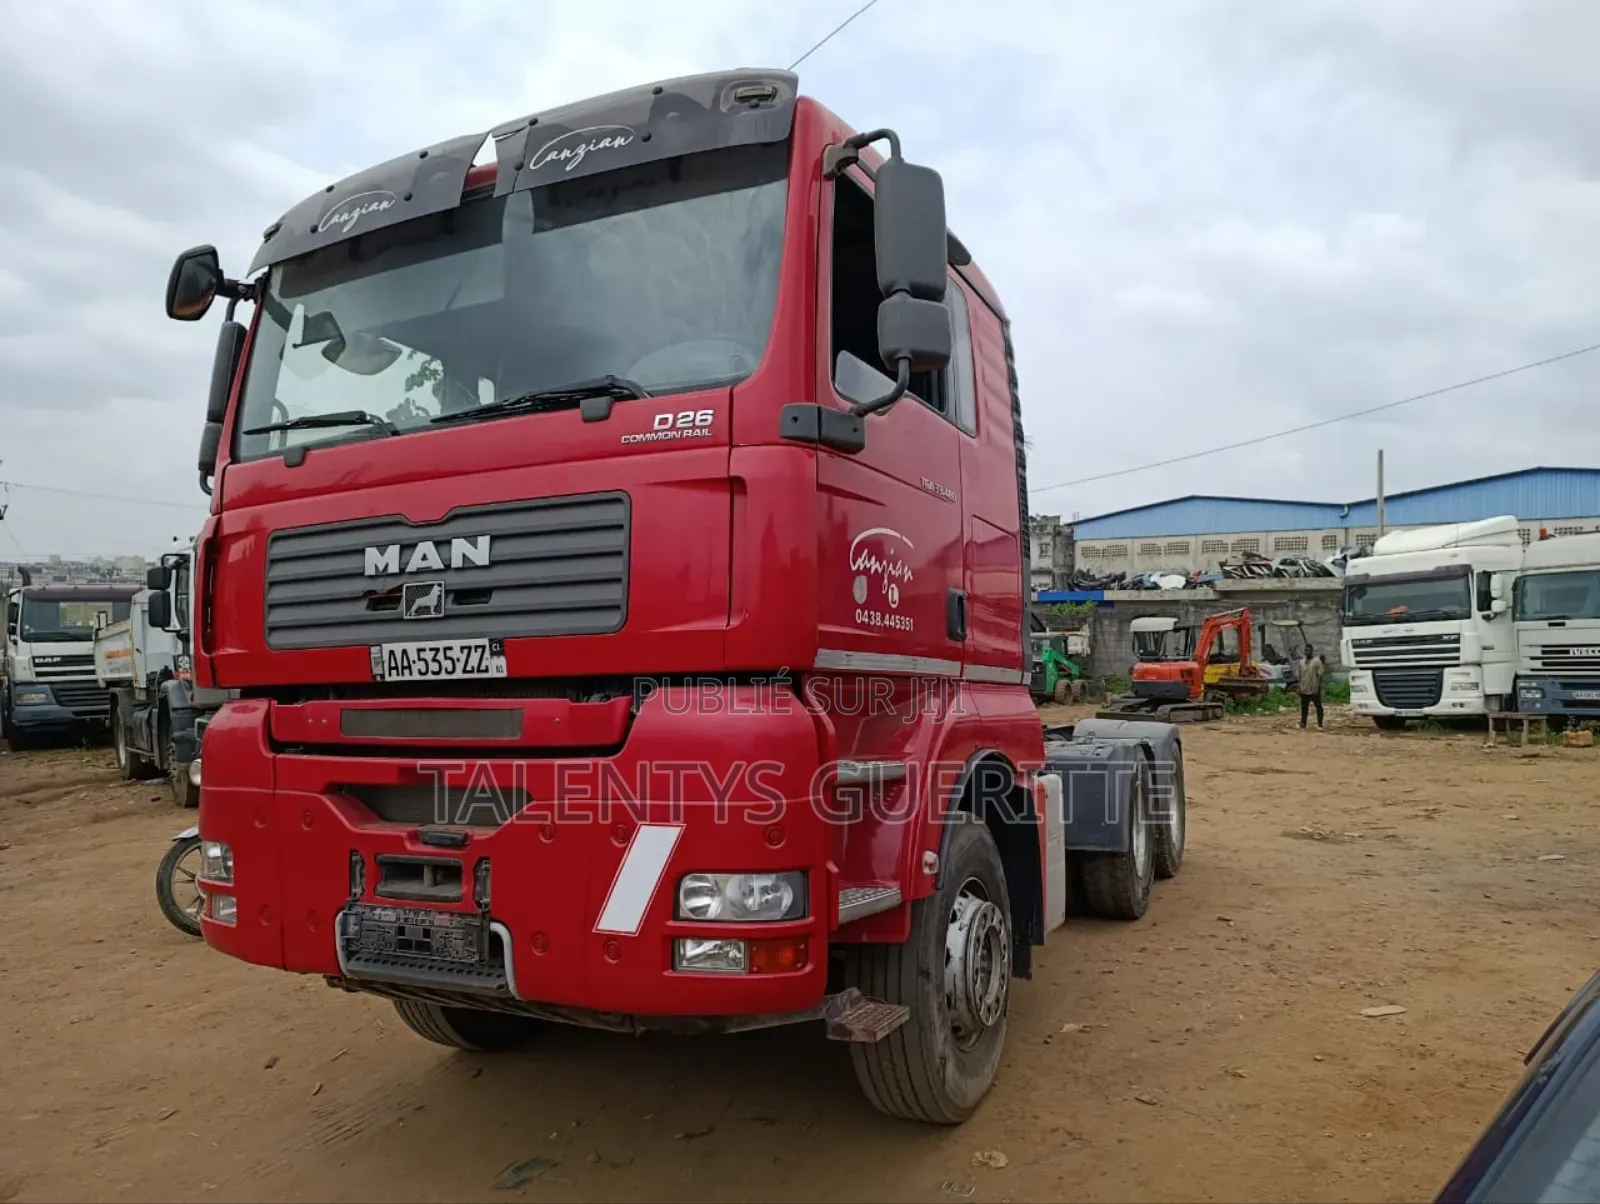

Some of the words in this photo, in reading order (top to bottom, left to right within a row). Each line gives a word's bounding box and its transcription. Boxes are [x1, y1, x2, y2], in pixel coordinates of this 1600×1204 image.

[653, 413, 673, 430] D
[676, 409, 714, 428] 26
[621, 431, 681, 444] COMMON
[683, 428, 712, 438] RAIL
[364, 535, 491, 576] MAN
